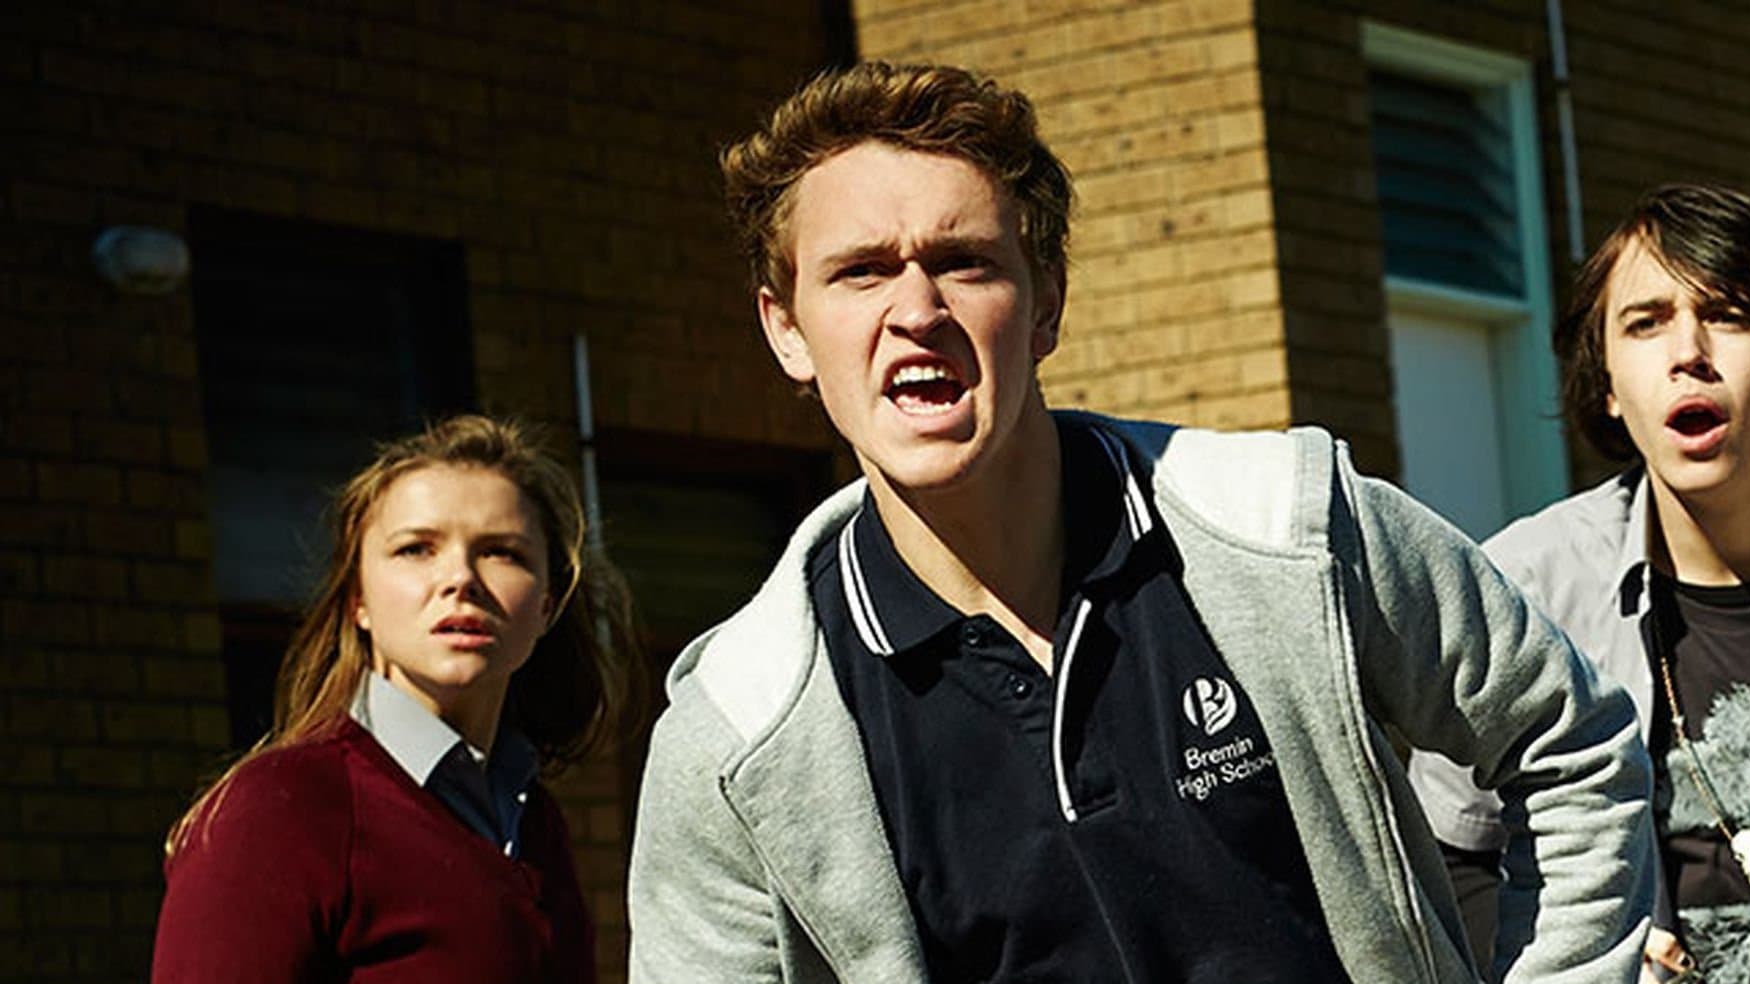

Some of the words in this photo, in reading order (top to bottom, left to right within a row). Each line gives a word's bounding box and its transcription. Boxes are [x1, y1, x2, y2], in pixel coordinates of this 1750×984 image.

[1184, 737, 1253, 770] Bremin
[1176, 770, 1218, 800] High
[1220, 751, 1273, 783] Schoo
